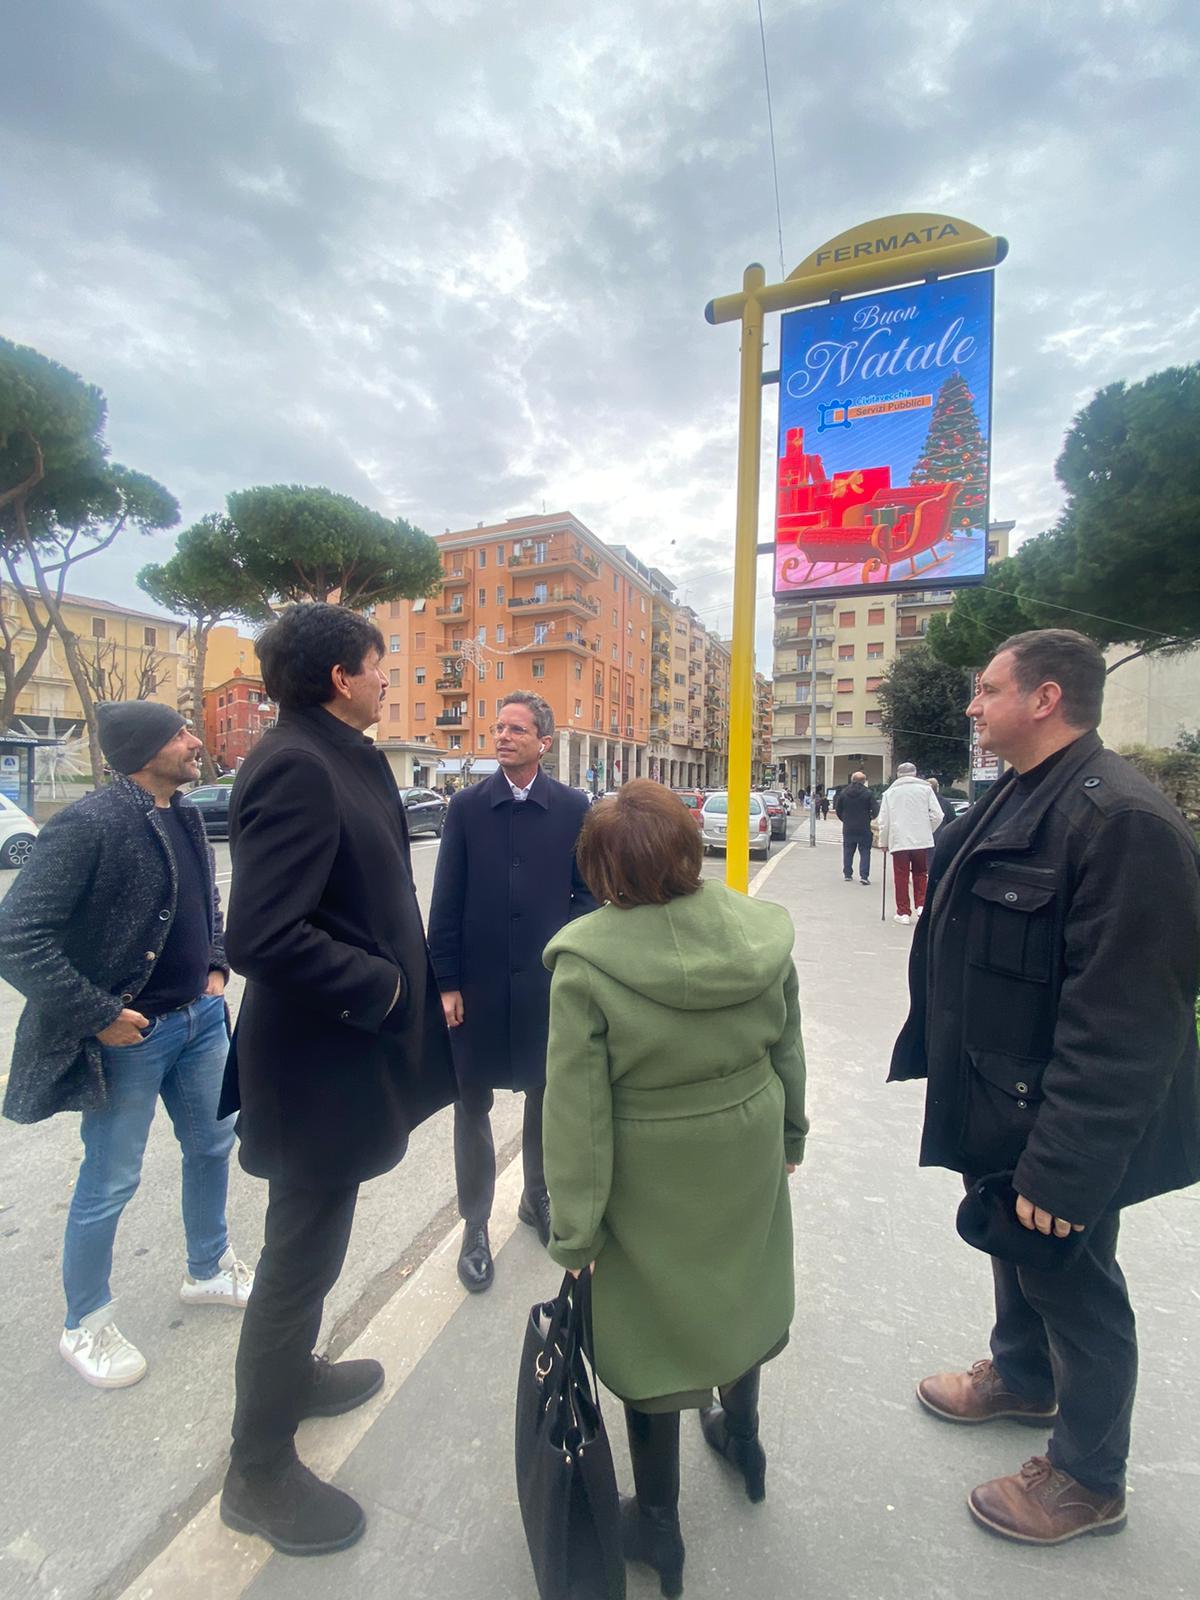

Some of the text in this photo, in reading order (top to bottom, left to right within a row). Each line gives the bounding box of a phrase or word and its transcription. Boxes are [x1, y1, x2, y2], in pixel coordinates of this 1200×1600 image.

[816, 223, 959, 266] FERMATA
[853, 305, 919, 331] Buon
[787, 317, 977, 398] Natale
[856, 390, 912, 405] Civitavecchia
[856, 398, 925, 416] Servizi Pubblici
